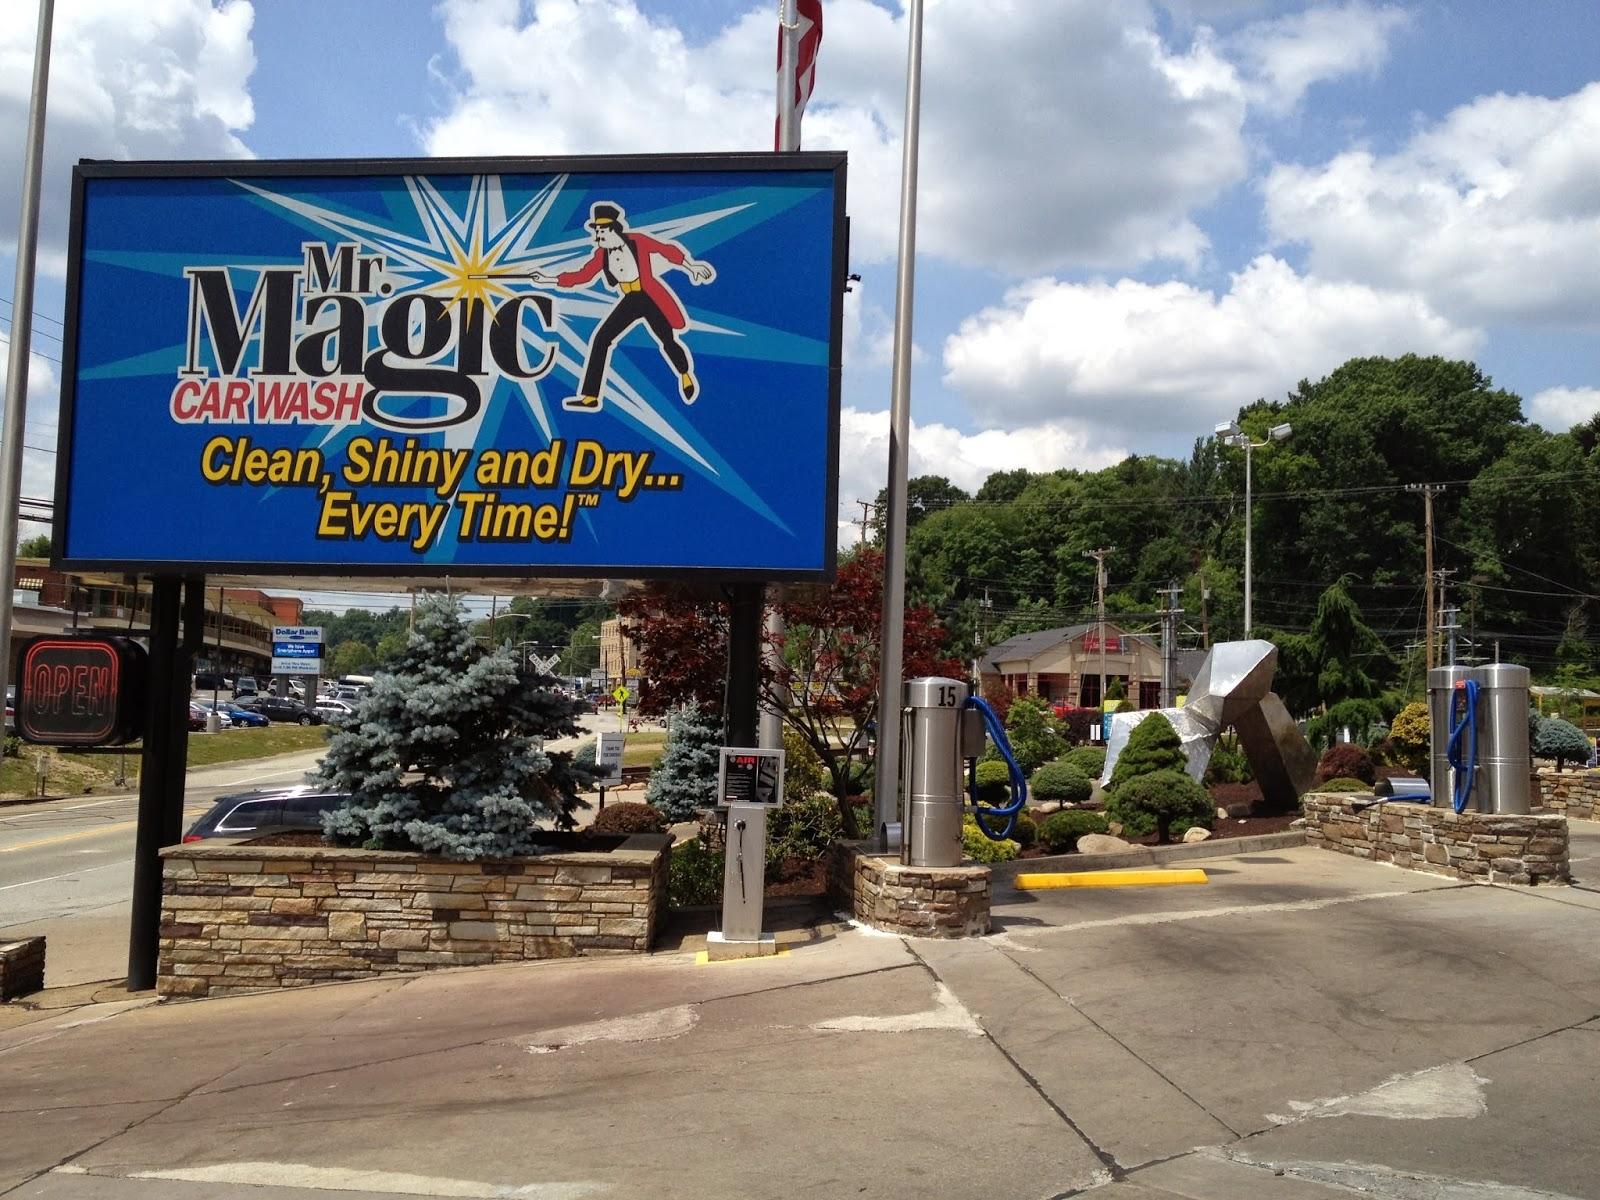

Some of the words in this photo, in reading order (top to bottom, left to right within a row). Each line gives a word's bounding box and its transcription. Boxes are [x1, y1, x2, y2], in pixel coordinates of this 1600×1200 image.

[304, 246, 392, 294] Mr.
[181, 270, 556, 429] Magic
[173, 381, 251, 421] CAR
[257, 381, 363, 421] WASH
[200, 436, 333, 494] Clean,
[343, 437, 469, 496] Shiny
[476, 440, 558, 486] and
[568, 440, 680, 498] Dry...
[317, 491, 452, 550] Every
[275, 628, 299, 636] Dollar
[299, 628, 319, 636] Bank
[34, 663, 109, 717] OPEN
[938, 686, 956, 707] 15
[736, 756, 755, 764] AIR
